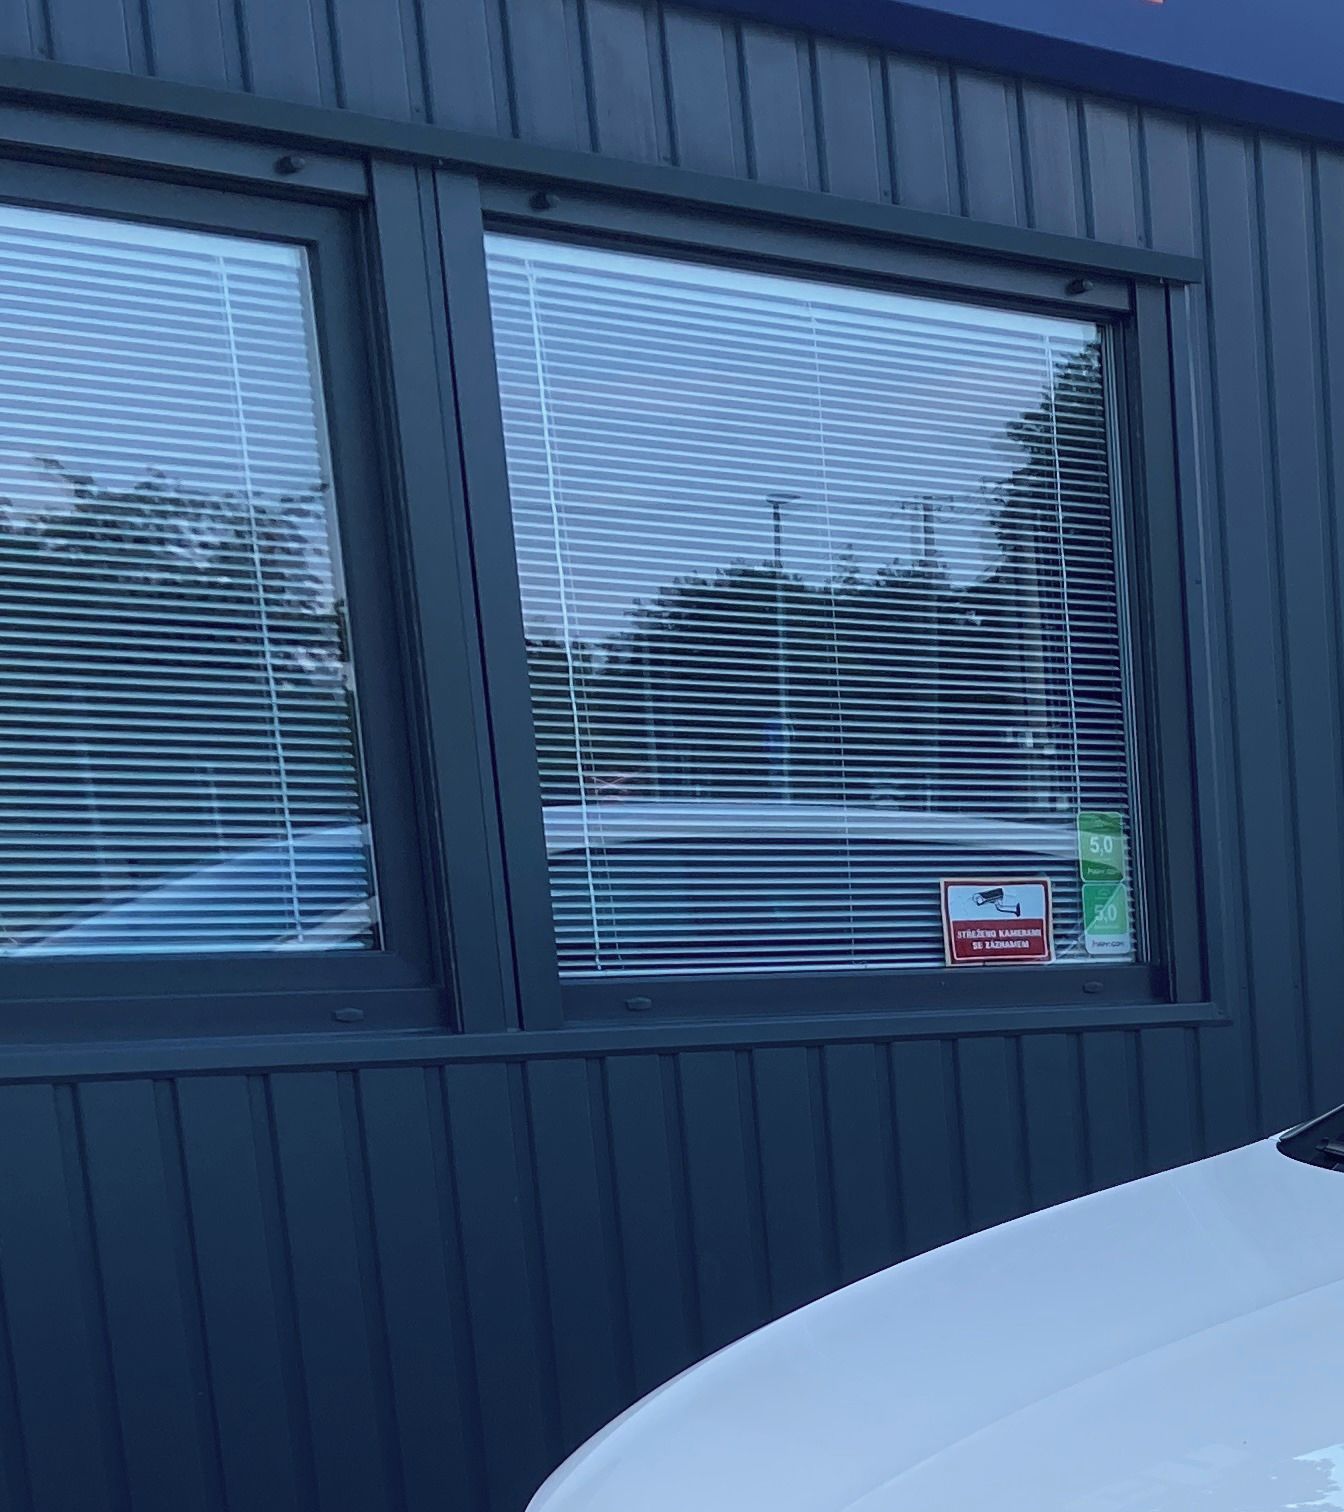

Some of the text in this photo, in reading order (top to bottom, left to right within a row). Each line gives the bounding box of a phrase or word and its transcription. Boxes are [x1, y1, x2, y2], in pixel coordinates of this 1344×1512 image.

[1090, 835, 1113, 857] 5,0
[1094, 904, 1118, 925] 5,0
[972, 941, 984, 950] SE
